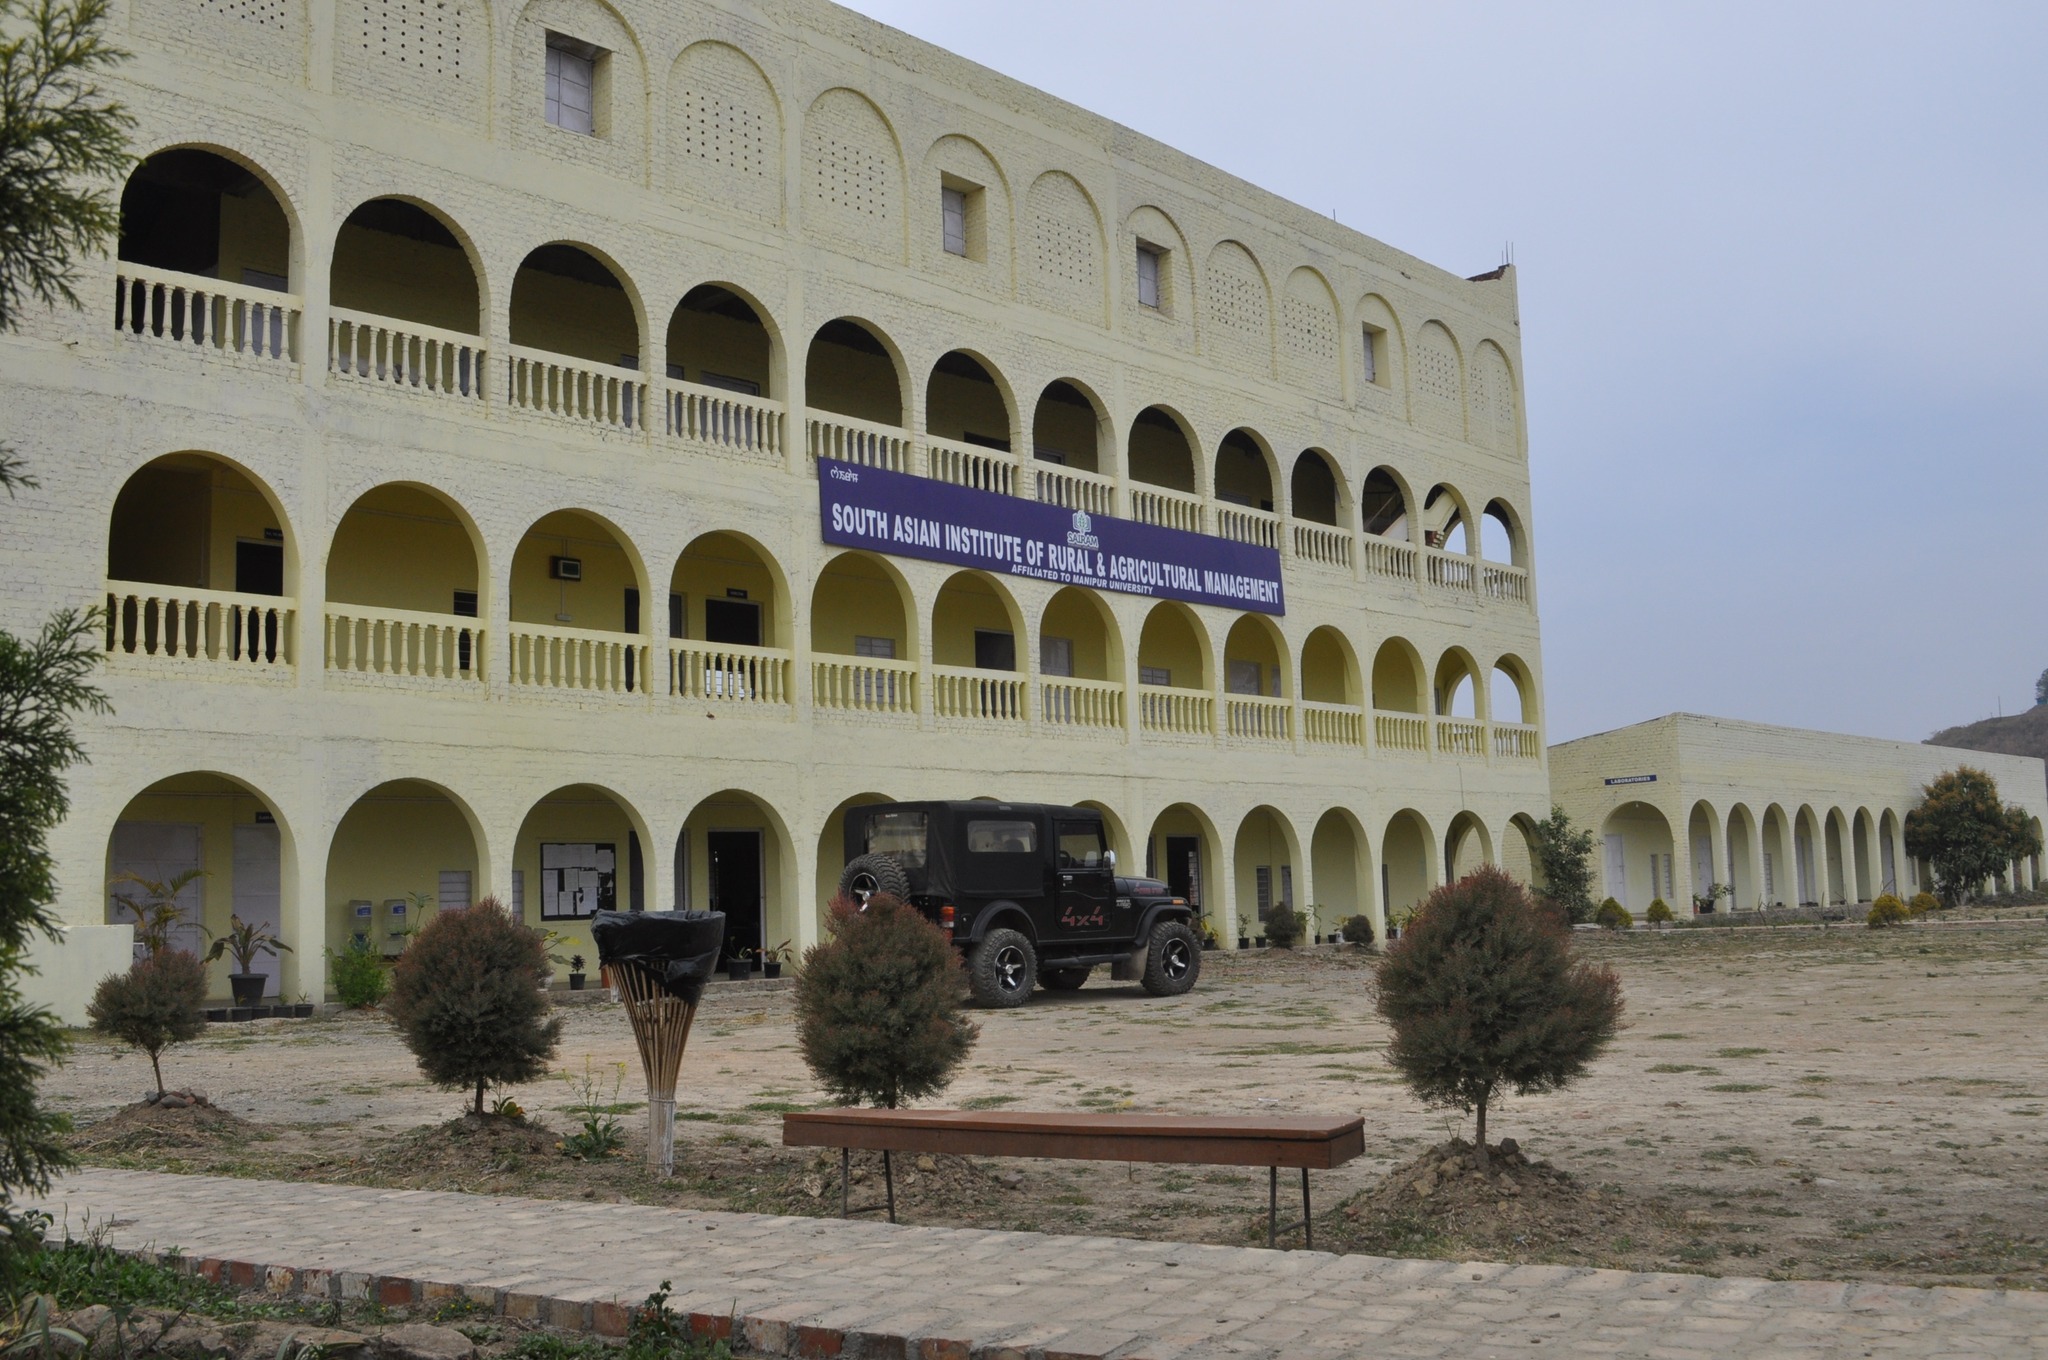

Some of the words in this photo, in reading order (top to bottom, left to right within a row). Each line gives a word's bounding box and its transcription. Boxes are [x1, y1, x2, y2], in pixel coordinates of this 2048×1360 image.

[1067, 531, 1099, 549] SAIRAM
[832, 502, 888, 539] SOUTH
[893, 514, 941, 548] ASIAN
[945, 524, 1022, 563] INSTITUTE
[1026, 539, 1044, 566] OF
[1048, 544, 1093, 575] RURAL
[1096, 553, 1106, 577] &
[1109, 554, 1202, 592] AGRICULTURAL
[1204, 570, 1279, 604] MANAGEMENT
[1011, 564, 1058, 580] AFFILIATED
[1060, 571, 1071, 582] TO
[1072, 574, 1107, 588] MANIPUR
[1109, 580, 1153, 595] UNIVERSITY
[1610, 776, 1651, 785] LABORATORIES
